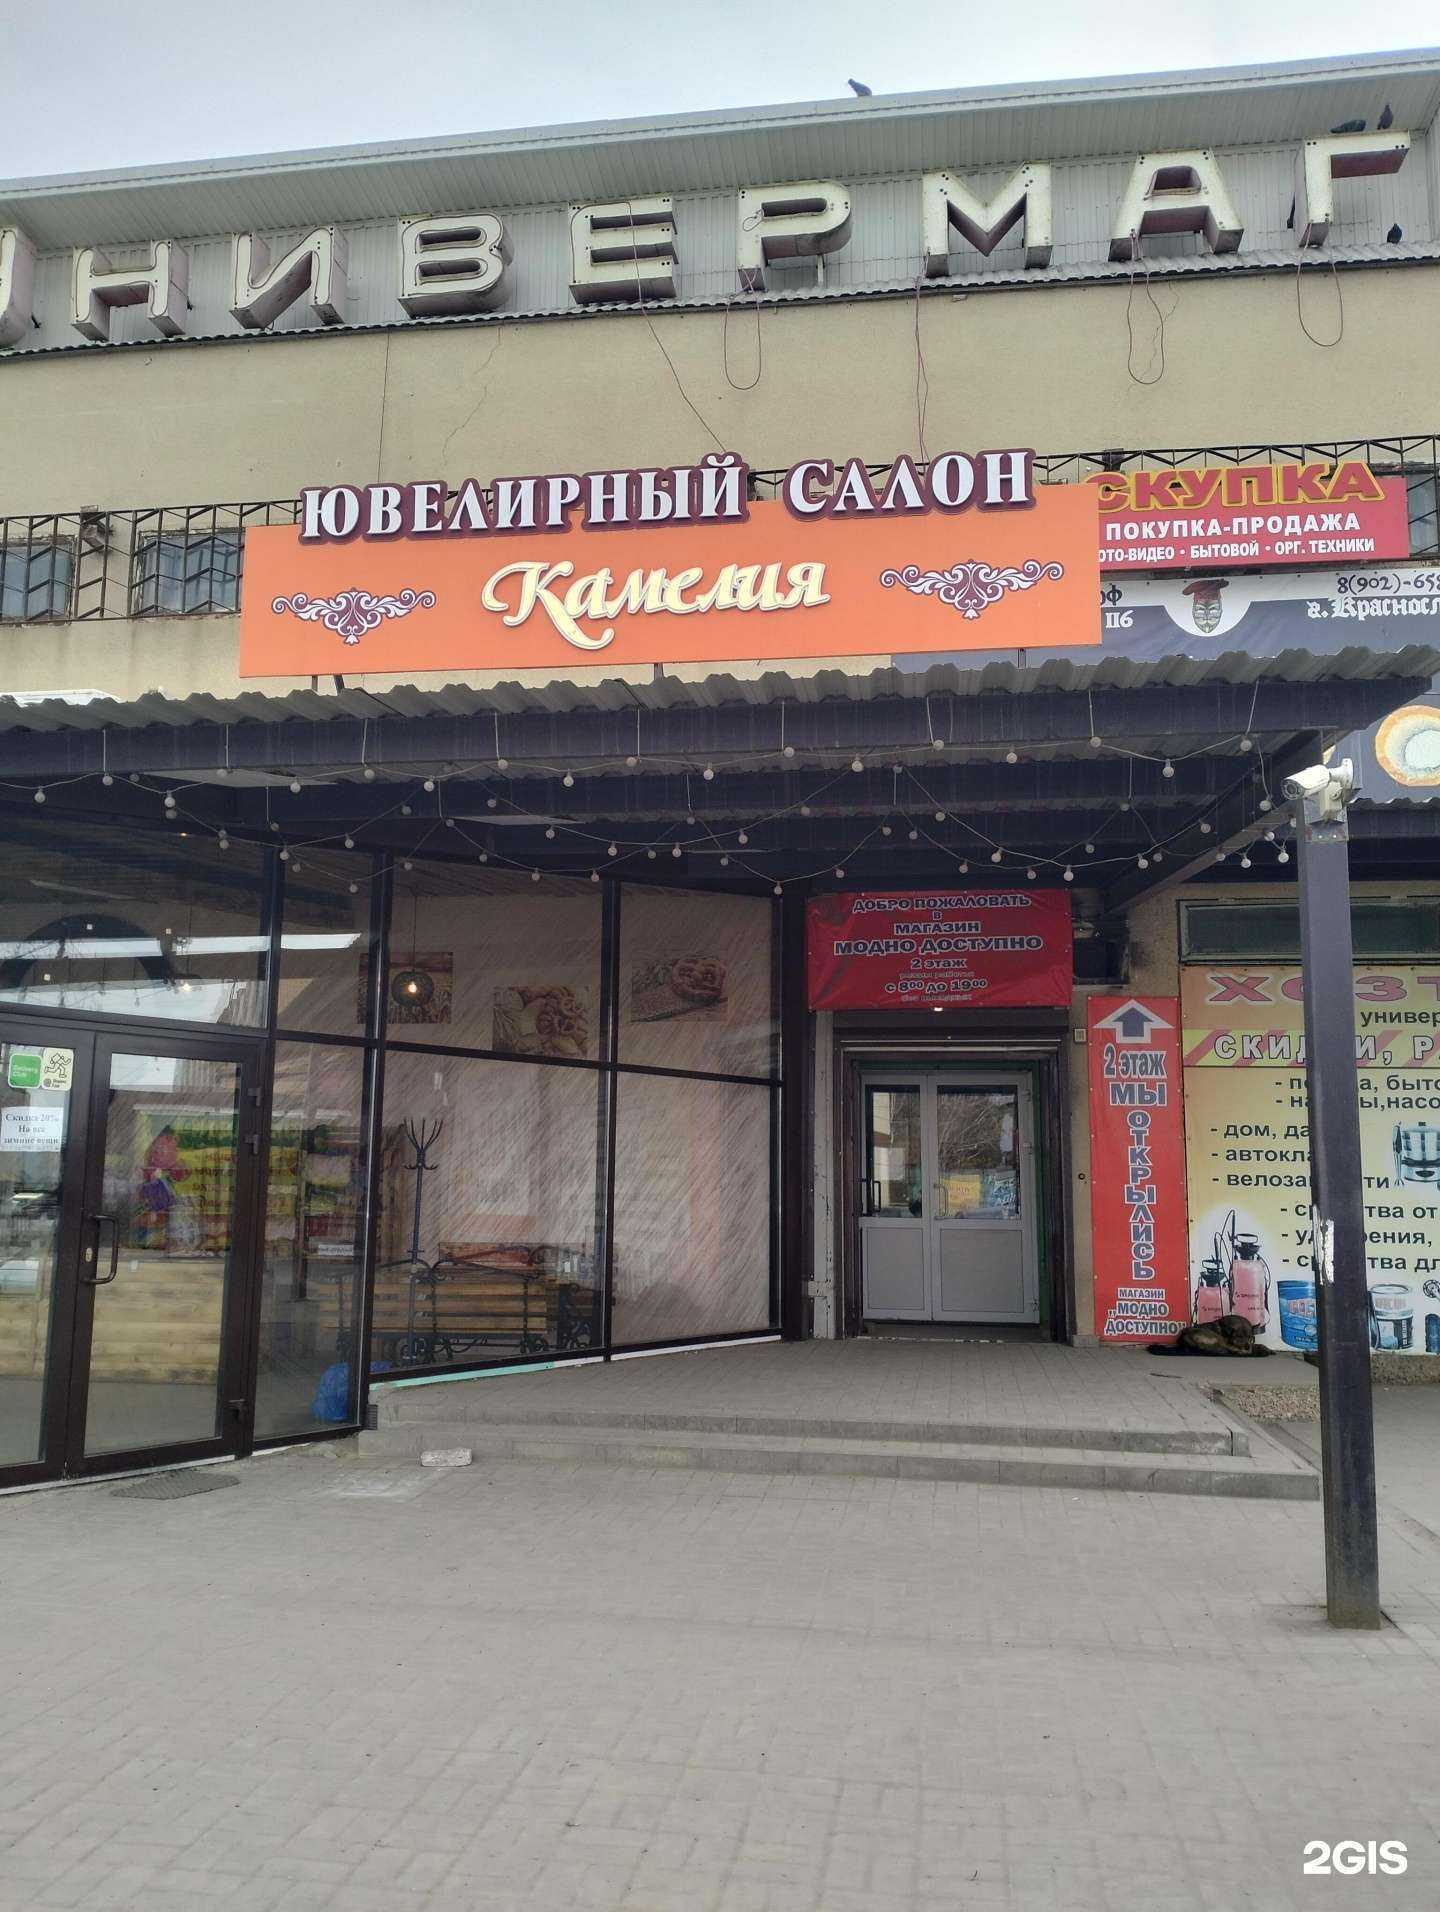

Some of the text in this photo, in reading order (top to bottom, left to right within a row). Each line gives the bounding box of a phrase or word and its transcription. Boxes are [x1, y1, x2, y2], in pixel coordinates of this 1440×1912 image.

[301, 450, 1032, 541] ЮВЕЛИРНЫЙ САЛОН
[1083, 462, 1386, 514] СКУПКА
[1105, 512, 1361, 541] ПОКУПКА-ПРОДАЖА
[1190, 540, 1259, 559] БЫТОВОЙ
[1275, 541, 1306, 555] ОРГ.
[1308, 538, 1375, 554] ТЕХНИКИ
[481, 560, 831, 651] Камелия
[853, 894, 1032, 913] ДОБРО ПОЖАЛОВАТЬ
[894, 921, 981, 936] МАГАЗИН
[834, 935, 1044, 956] МОДНО ДОСТУПНО
[911, 957, 967, 970] 2 этаж
[1412, 1034, 1440, 1061] Р
[1103, 1042, 1167, 1079] 2 этаж
[1109, 1083, 1167, 1107] МЫ
[1224, 1123, 1277, 1140] дом,
[1118, 1287, 1166, 1301] МАГАЗИН
